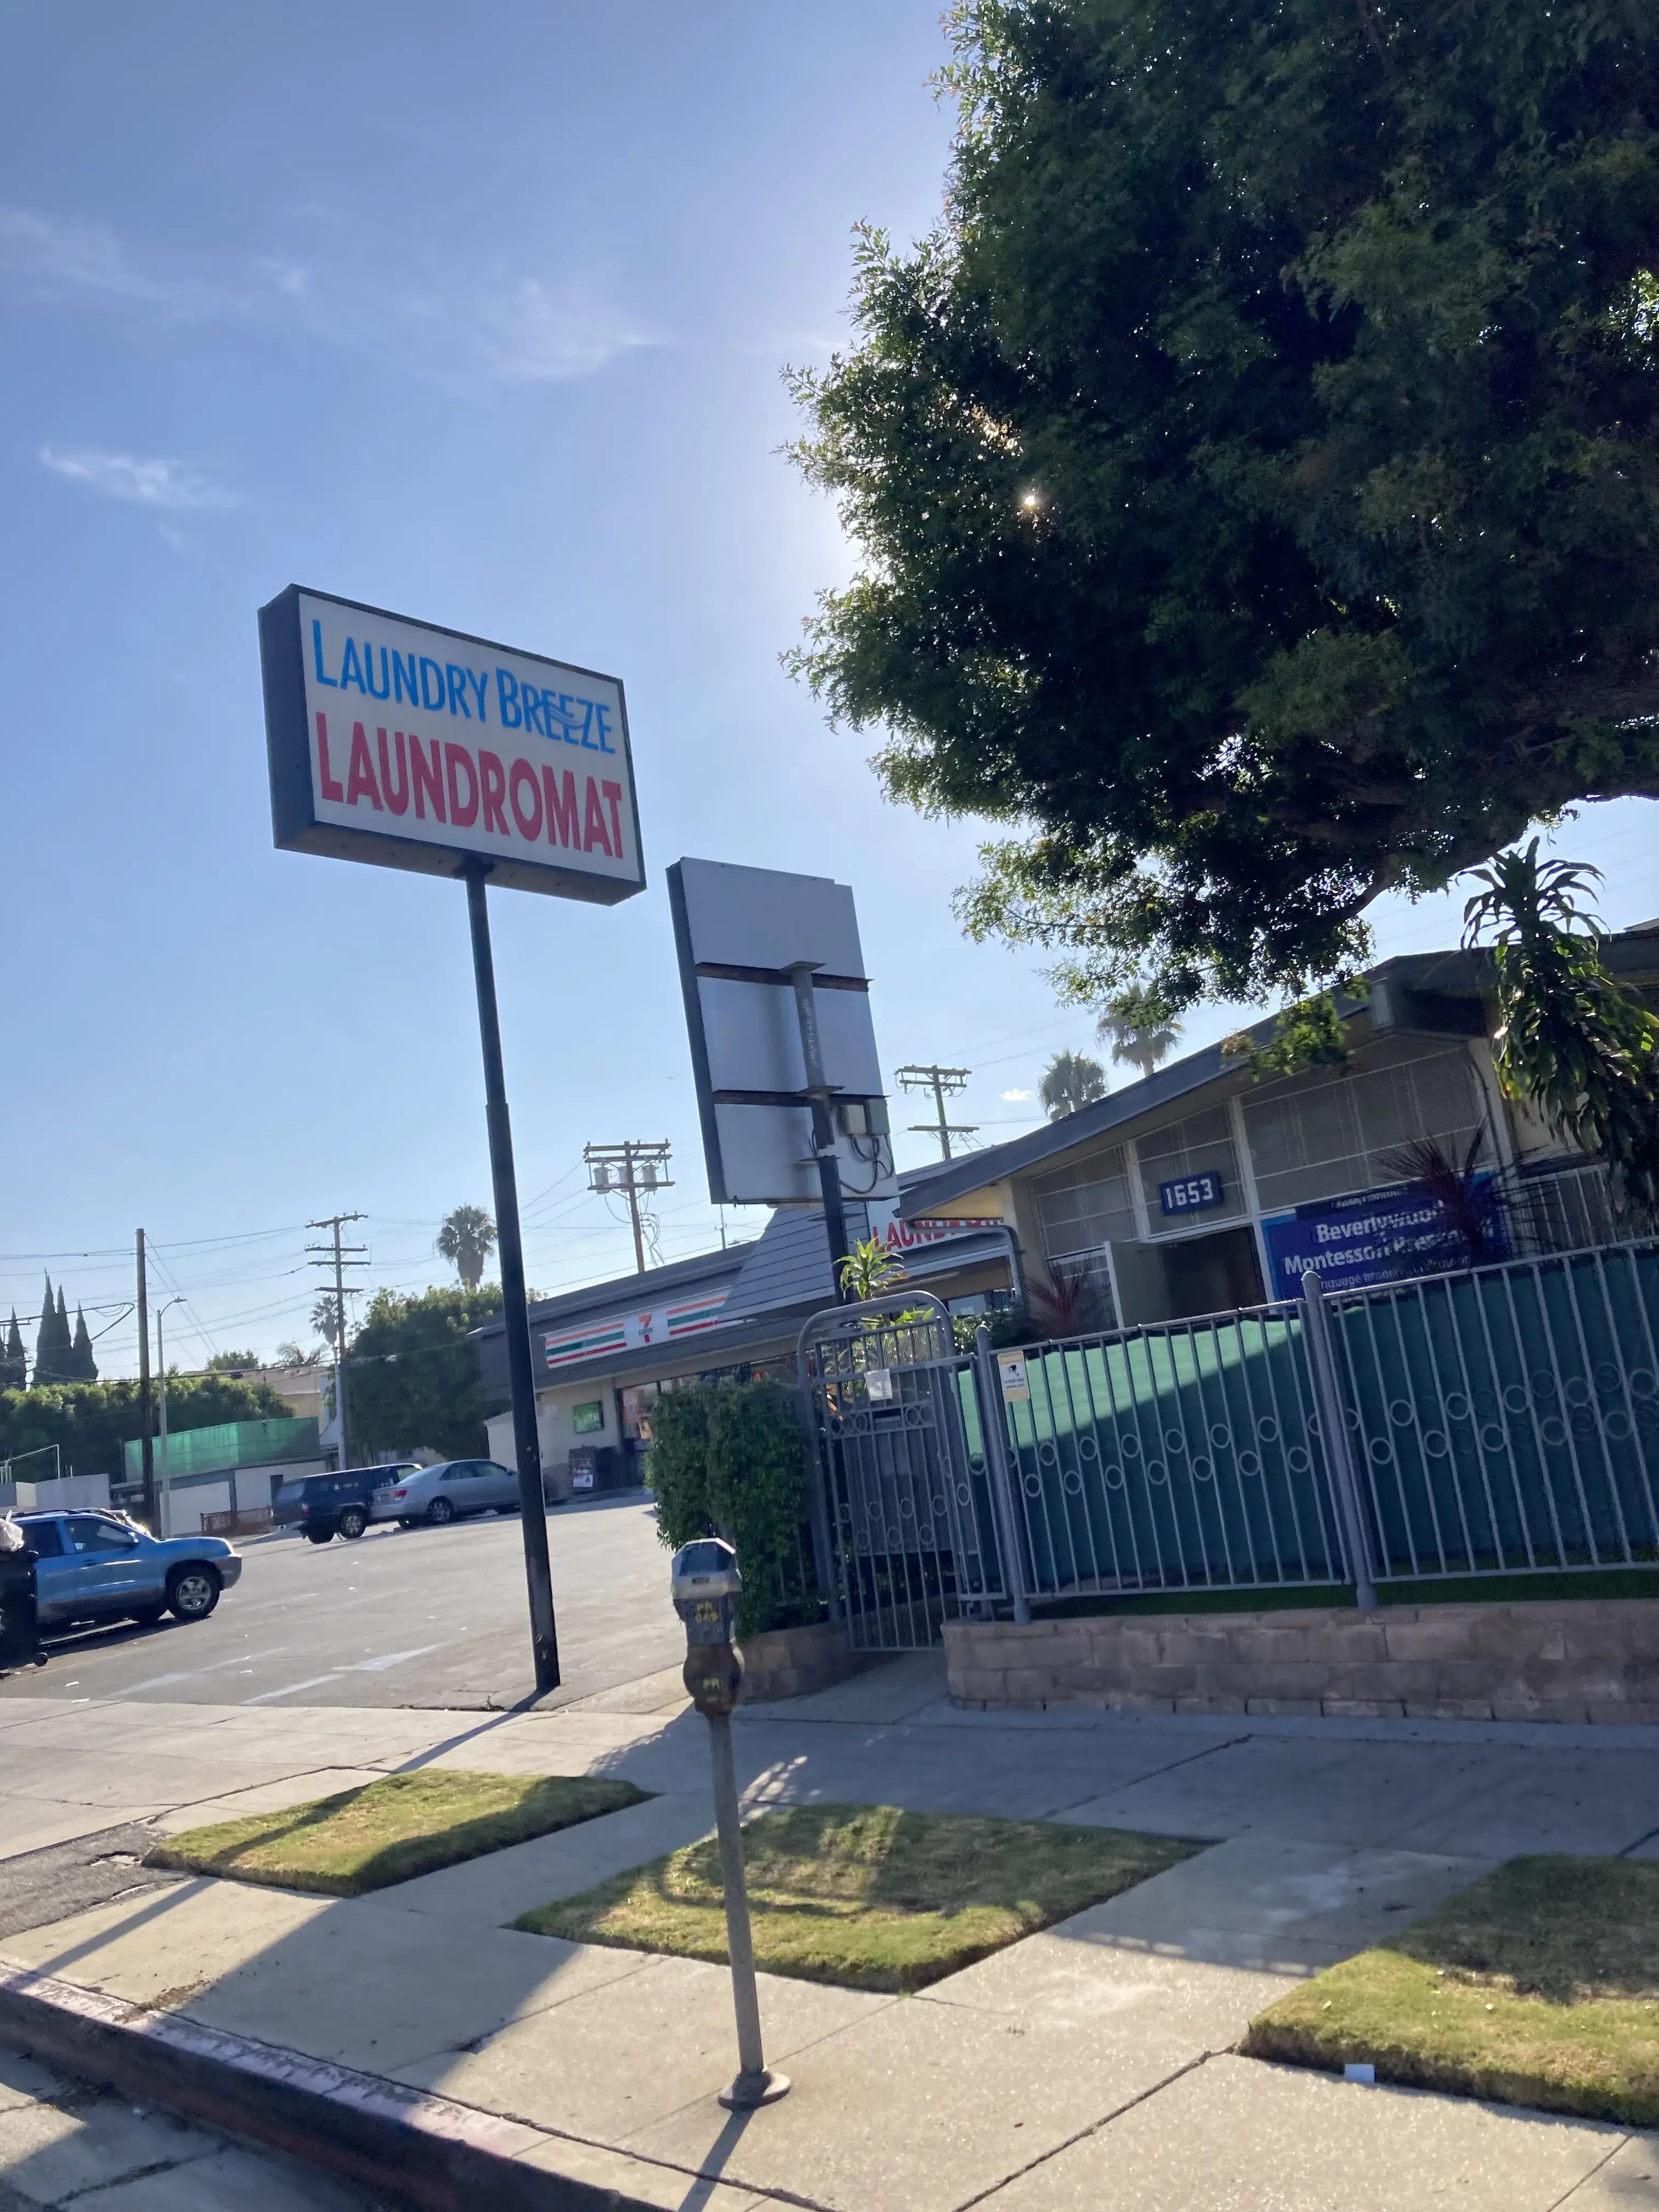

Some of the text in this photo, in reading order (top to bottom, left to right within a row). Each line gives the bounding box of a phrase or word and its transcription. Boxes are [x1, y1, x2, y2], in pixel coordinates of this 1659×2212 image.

[312, 619, 616, 754] LAUNDRY BREEZE
[316, 711, 623, 859] LAUNDROMAT
[1166, 1178, 1213, 1209] 1653
